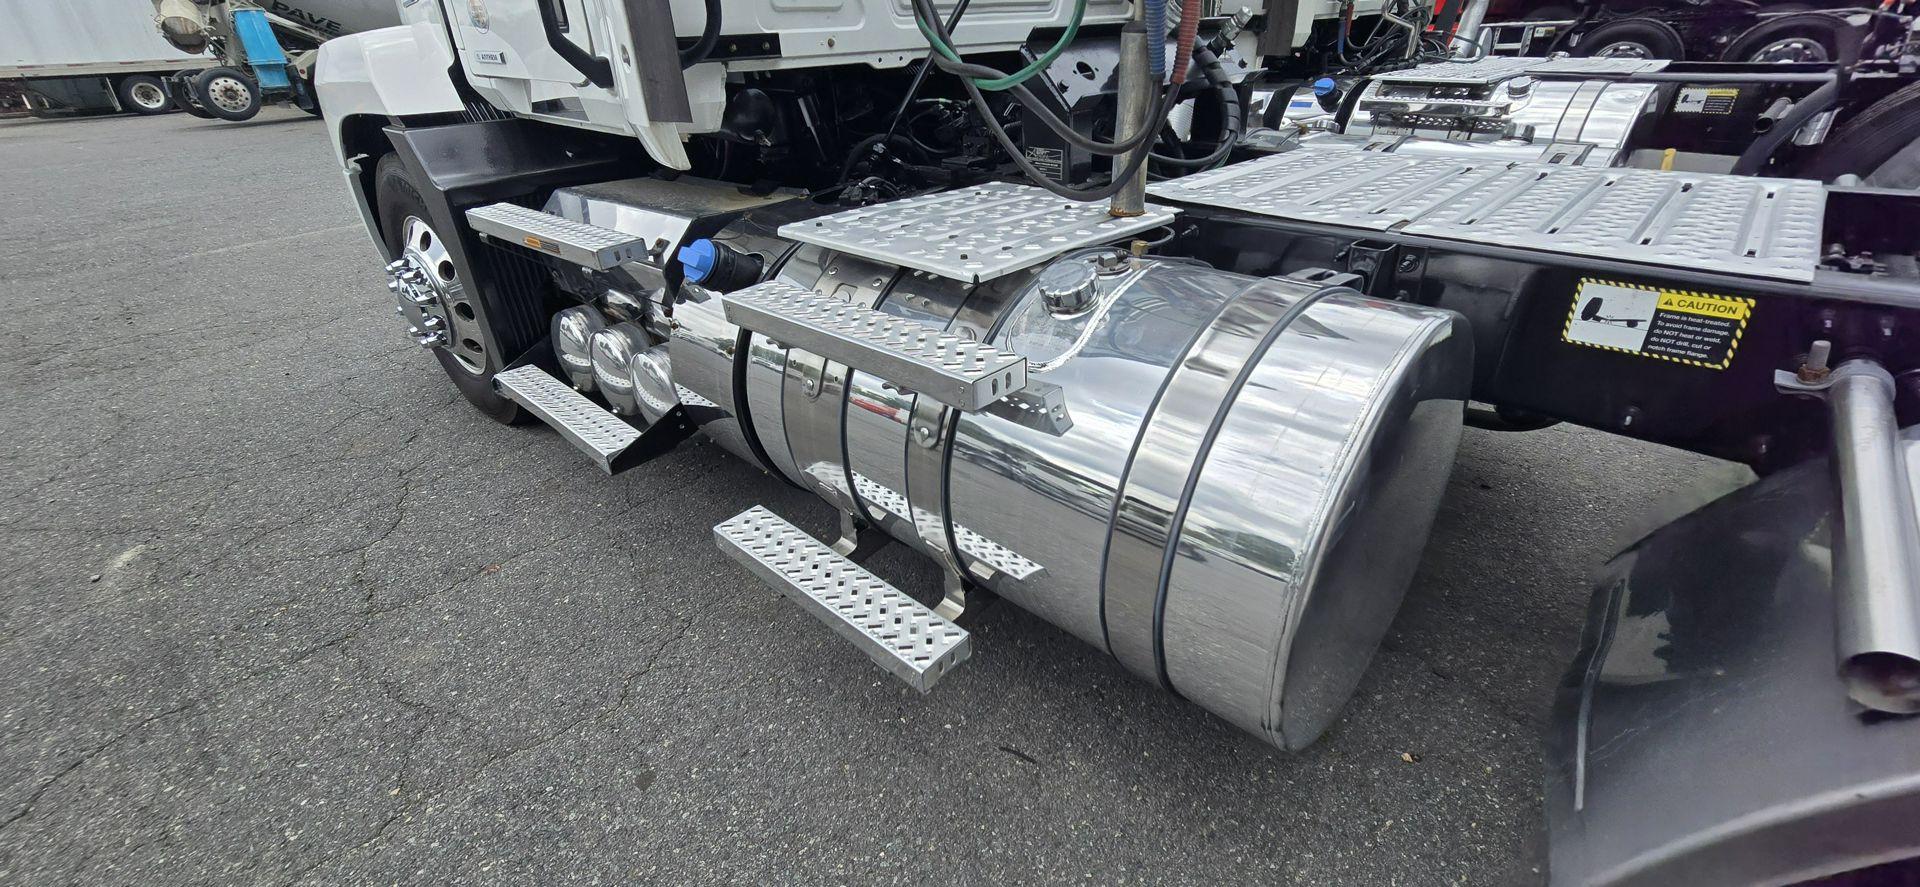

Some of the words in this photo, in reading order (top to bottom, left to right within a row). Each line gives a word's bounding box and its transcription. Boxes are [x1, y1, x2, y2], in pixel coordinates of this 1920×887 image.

[272, 0, 342, 33] PAVE
[1677, 299, 1738, 315] CAUTION
[1660, 312, 1680, 320] Frame
[1688, 317, 1731, 327] heat-treated.
[1683, 324, 1701, 332] frame
[1666, 347, 1686, 355] frame
